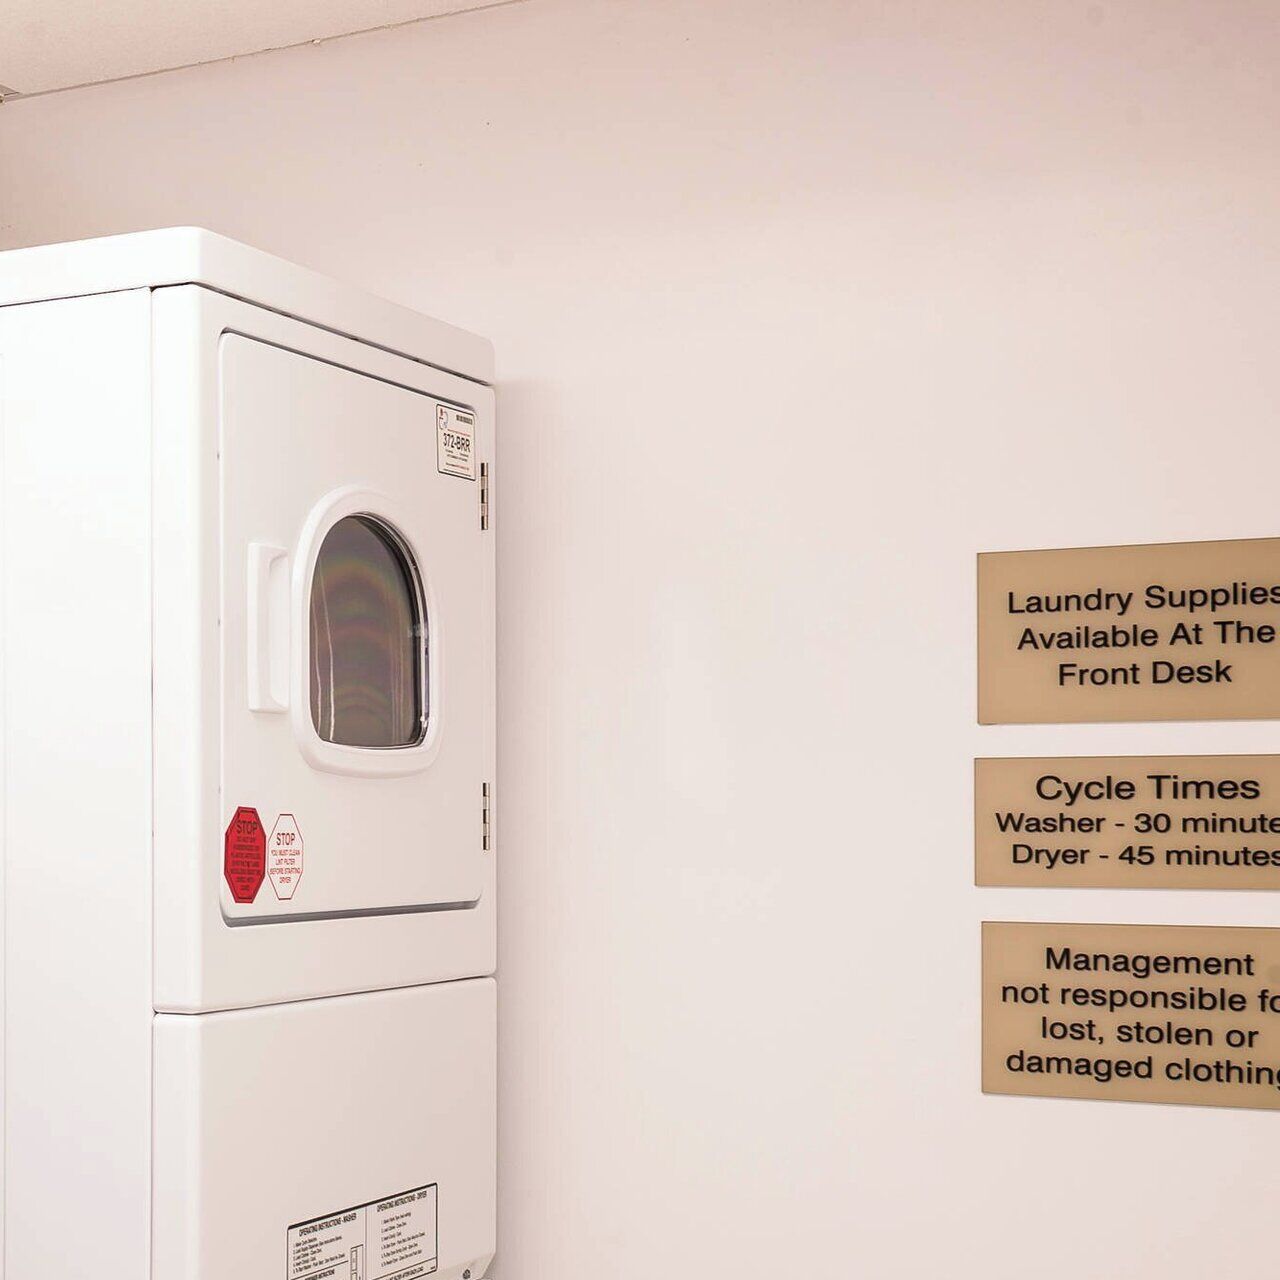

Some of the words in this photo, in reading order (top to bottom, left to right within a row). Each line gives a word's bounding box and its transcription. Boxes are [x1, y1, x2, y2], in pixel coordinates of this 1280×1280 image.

[443, 433, 470, 452] 372-BRR
[1009, 588, 1133, 616] Laundry
[1145, 582, 1280, 613] Supplies
[1018, 625, 1158, 650] Available
[1170, 623, 1202, 645] At
[1213, 621, 1275, 644] The
[1060, 664, 1140, 685] Front
[1153, 660, 1232, 683] Desk
[1036, 776, 1135, 806] Cycle
[1147, 775, 1260, 799] Times
[237, 820, 257, 834] STOP
[996, 813, 1106, 833] Washer
[1134, 813, 1171, 833] 30
[276, 833, 295, 845] STOP
[1013, 844, 1090, 869] Dryer
[1119, 846, 1154, 865] 45
[1047, 948, 1254, 978] Management
[1003, 983, 1049, 1004] not
[1061, 987, 1246, 1012] responsible
[1042, 1017, 1103, 1044] lost,
[1117, 1022, 1212, 1046] stolen
[1226, 1030, 1259, 1047] or
[1007, 1050, 1152, 1082] damaged
